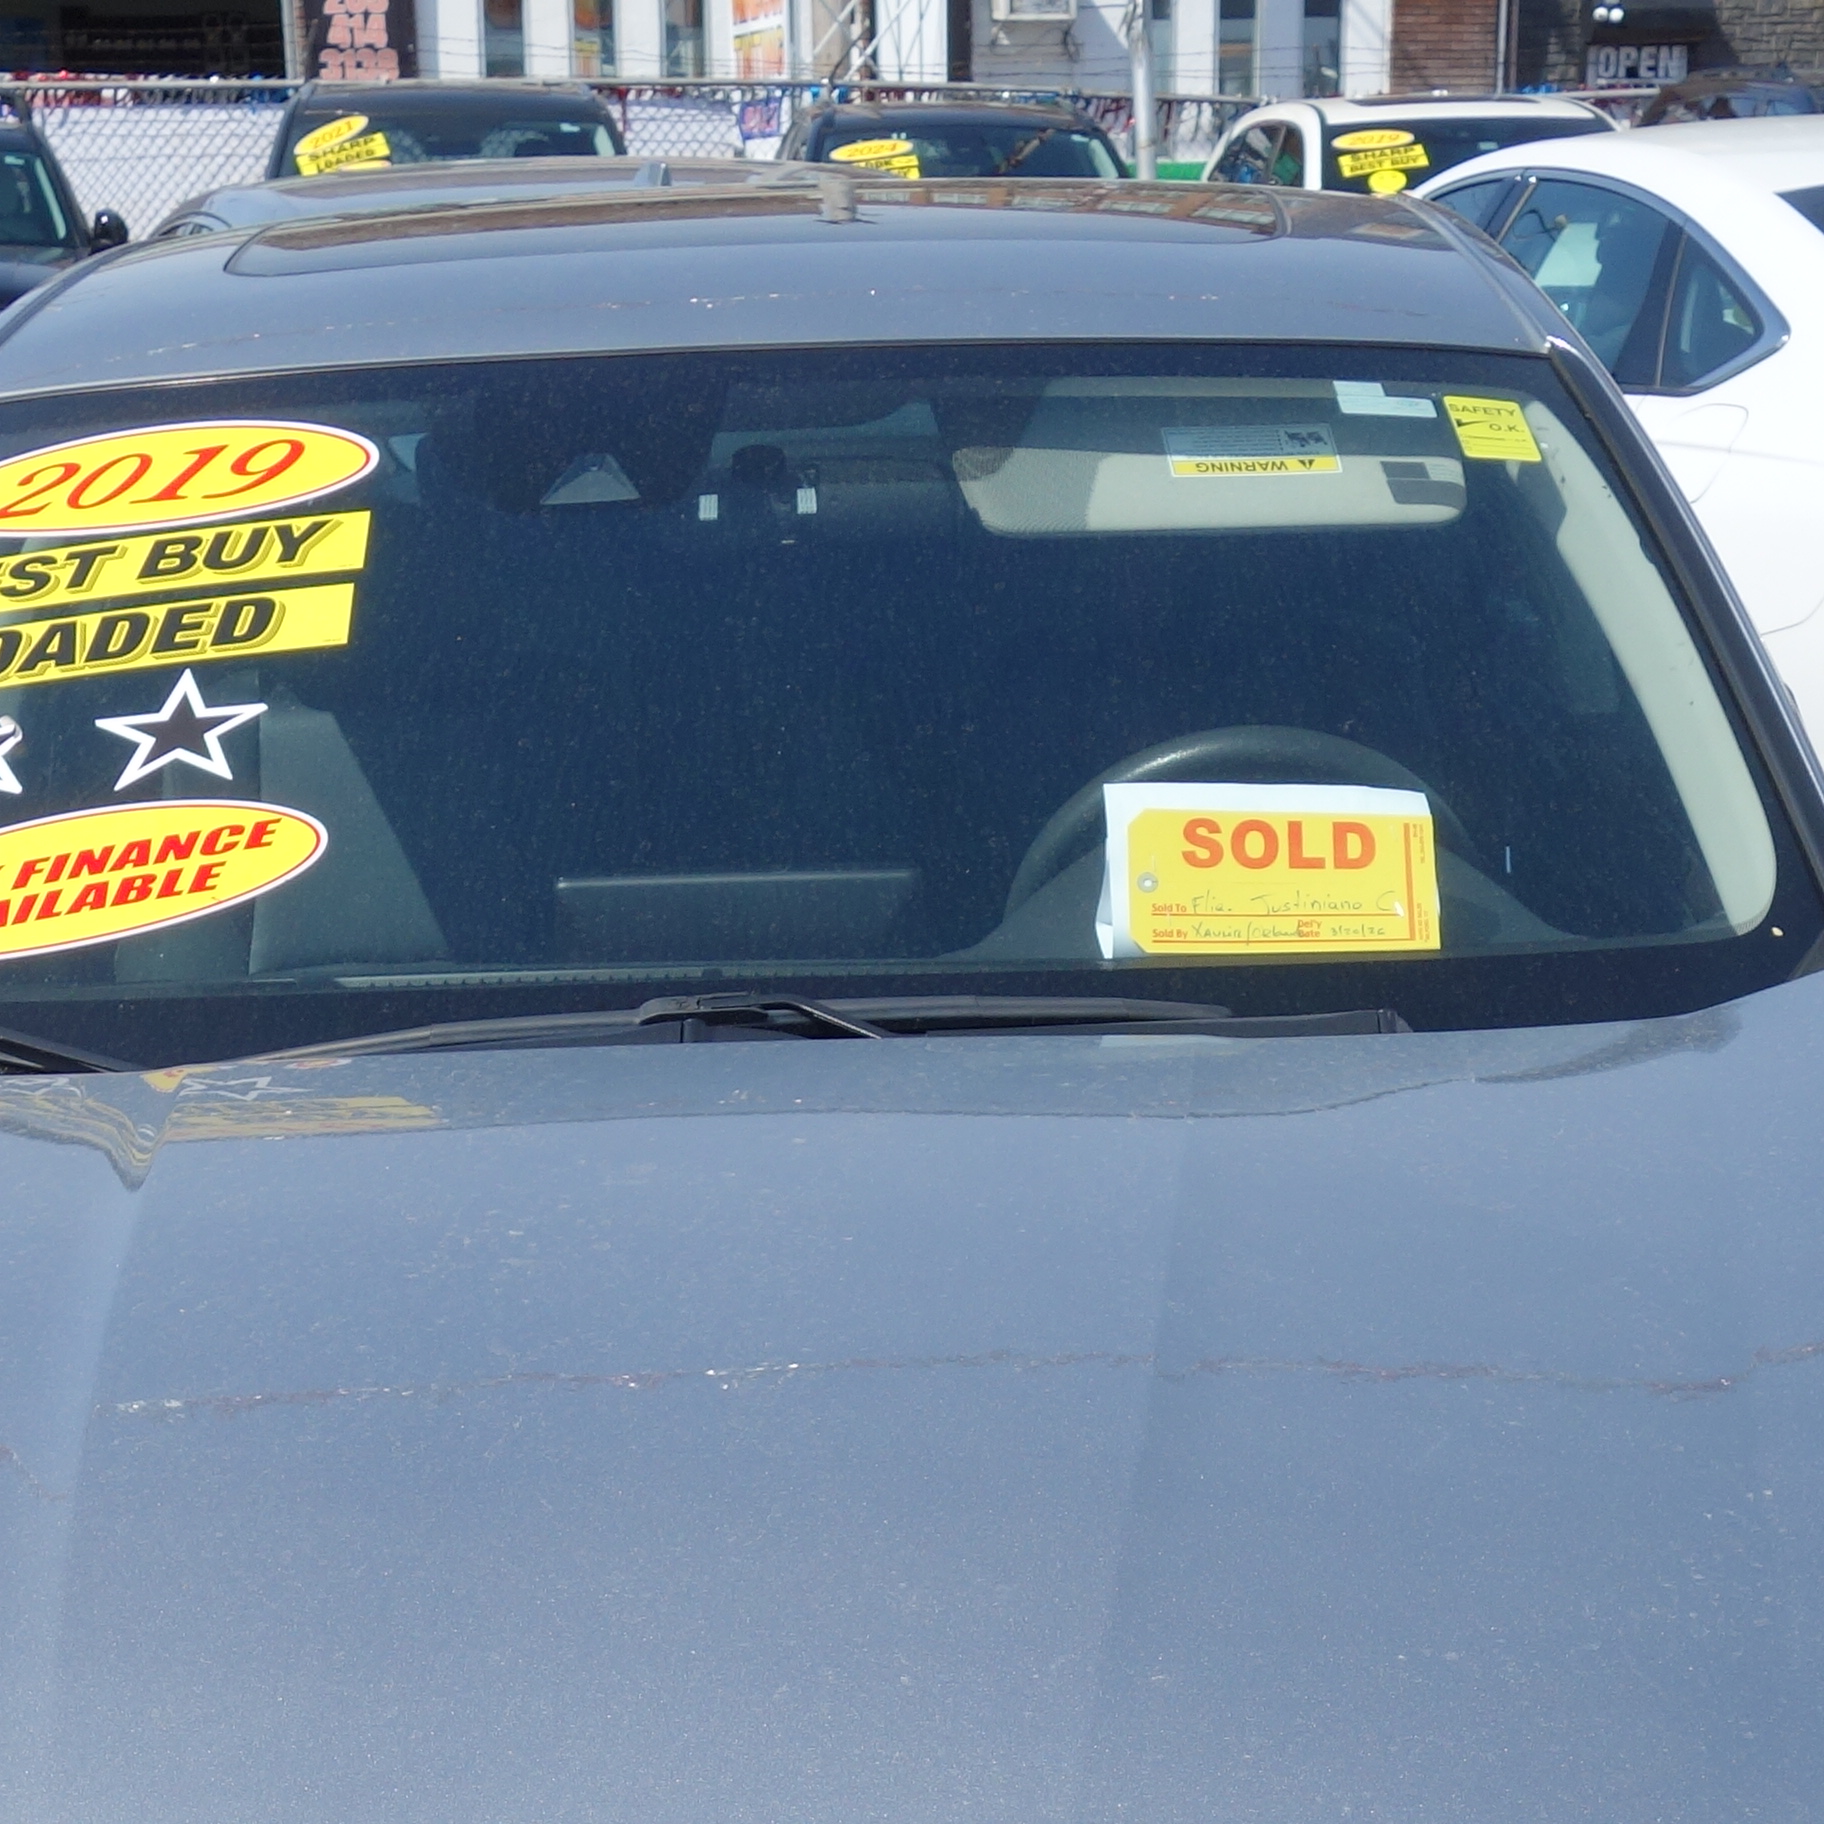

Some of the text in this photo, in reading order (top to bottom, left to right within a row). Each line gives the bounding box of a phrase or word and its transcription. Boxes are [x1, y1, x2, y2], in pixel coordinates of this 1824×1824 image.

[1598, 45, 1687, 78] OPEN
[312, 121, 354, 149] 2021
[308, 137, 376, 161] SHARP
[1350, 147, 1416, 162] SHARP
[1350, 160, 1386, 173] BEST
[1448, 403, 1517, 416] SAFETY
[1489, 423, 1525, 432] O.K.
[1195, 460, 1289, 473] WARNING
[136, 519, 344, 583] BUY
[1181, 817, 1377, 870] SOLD
[11, 817, 283, 890] FINANCE
[1152, 903, 1187, 913] Sold To
[1152, 928, 1188, 940] Sold By
